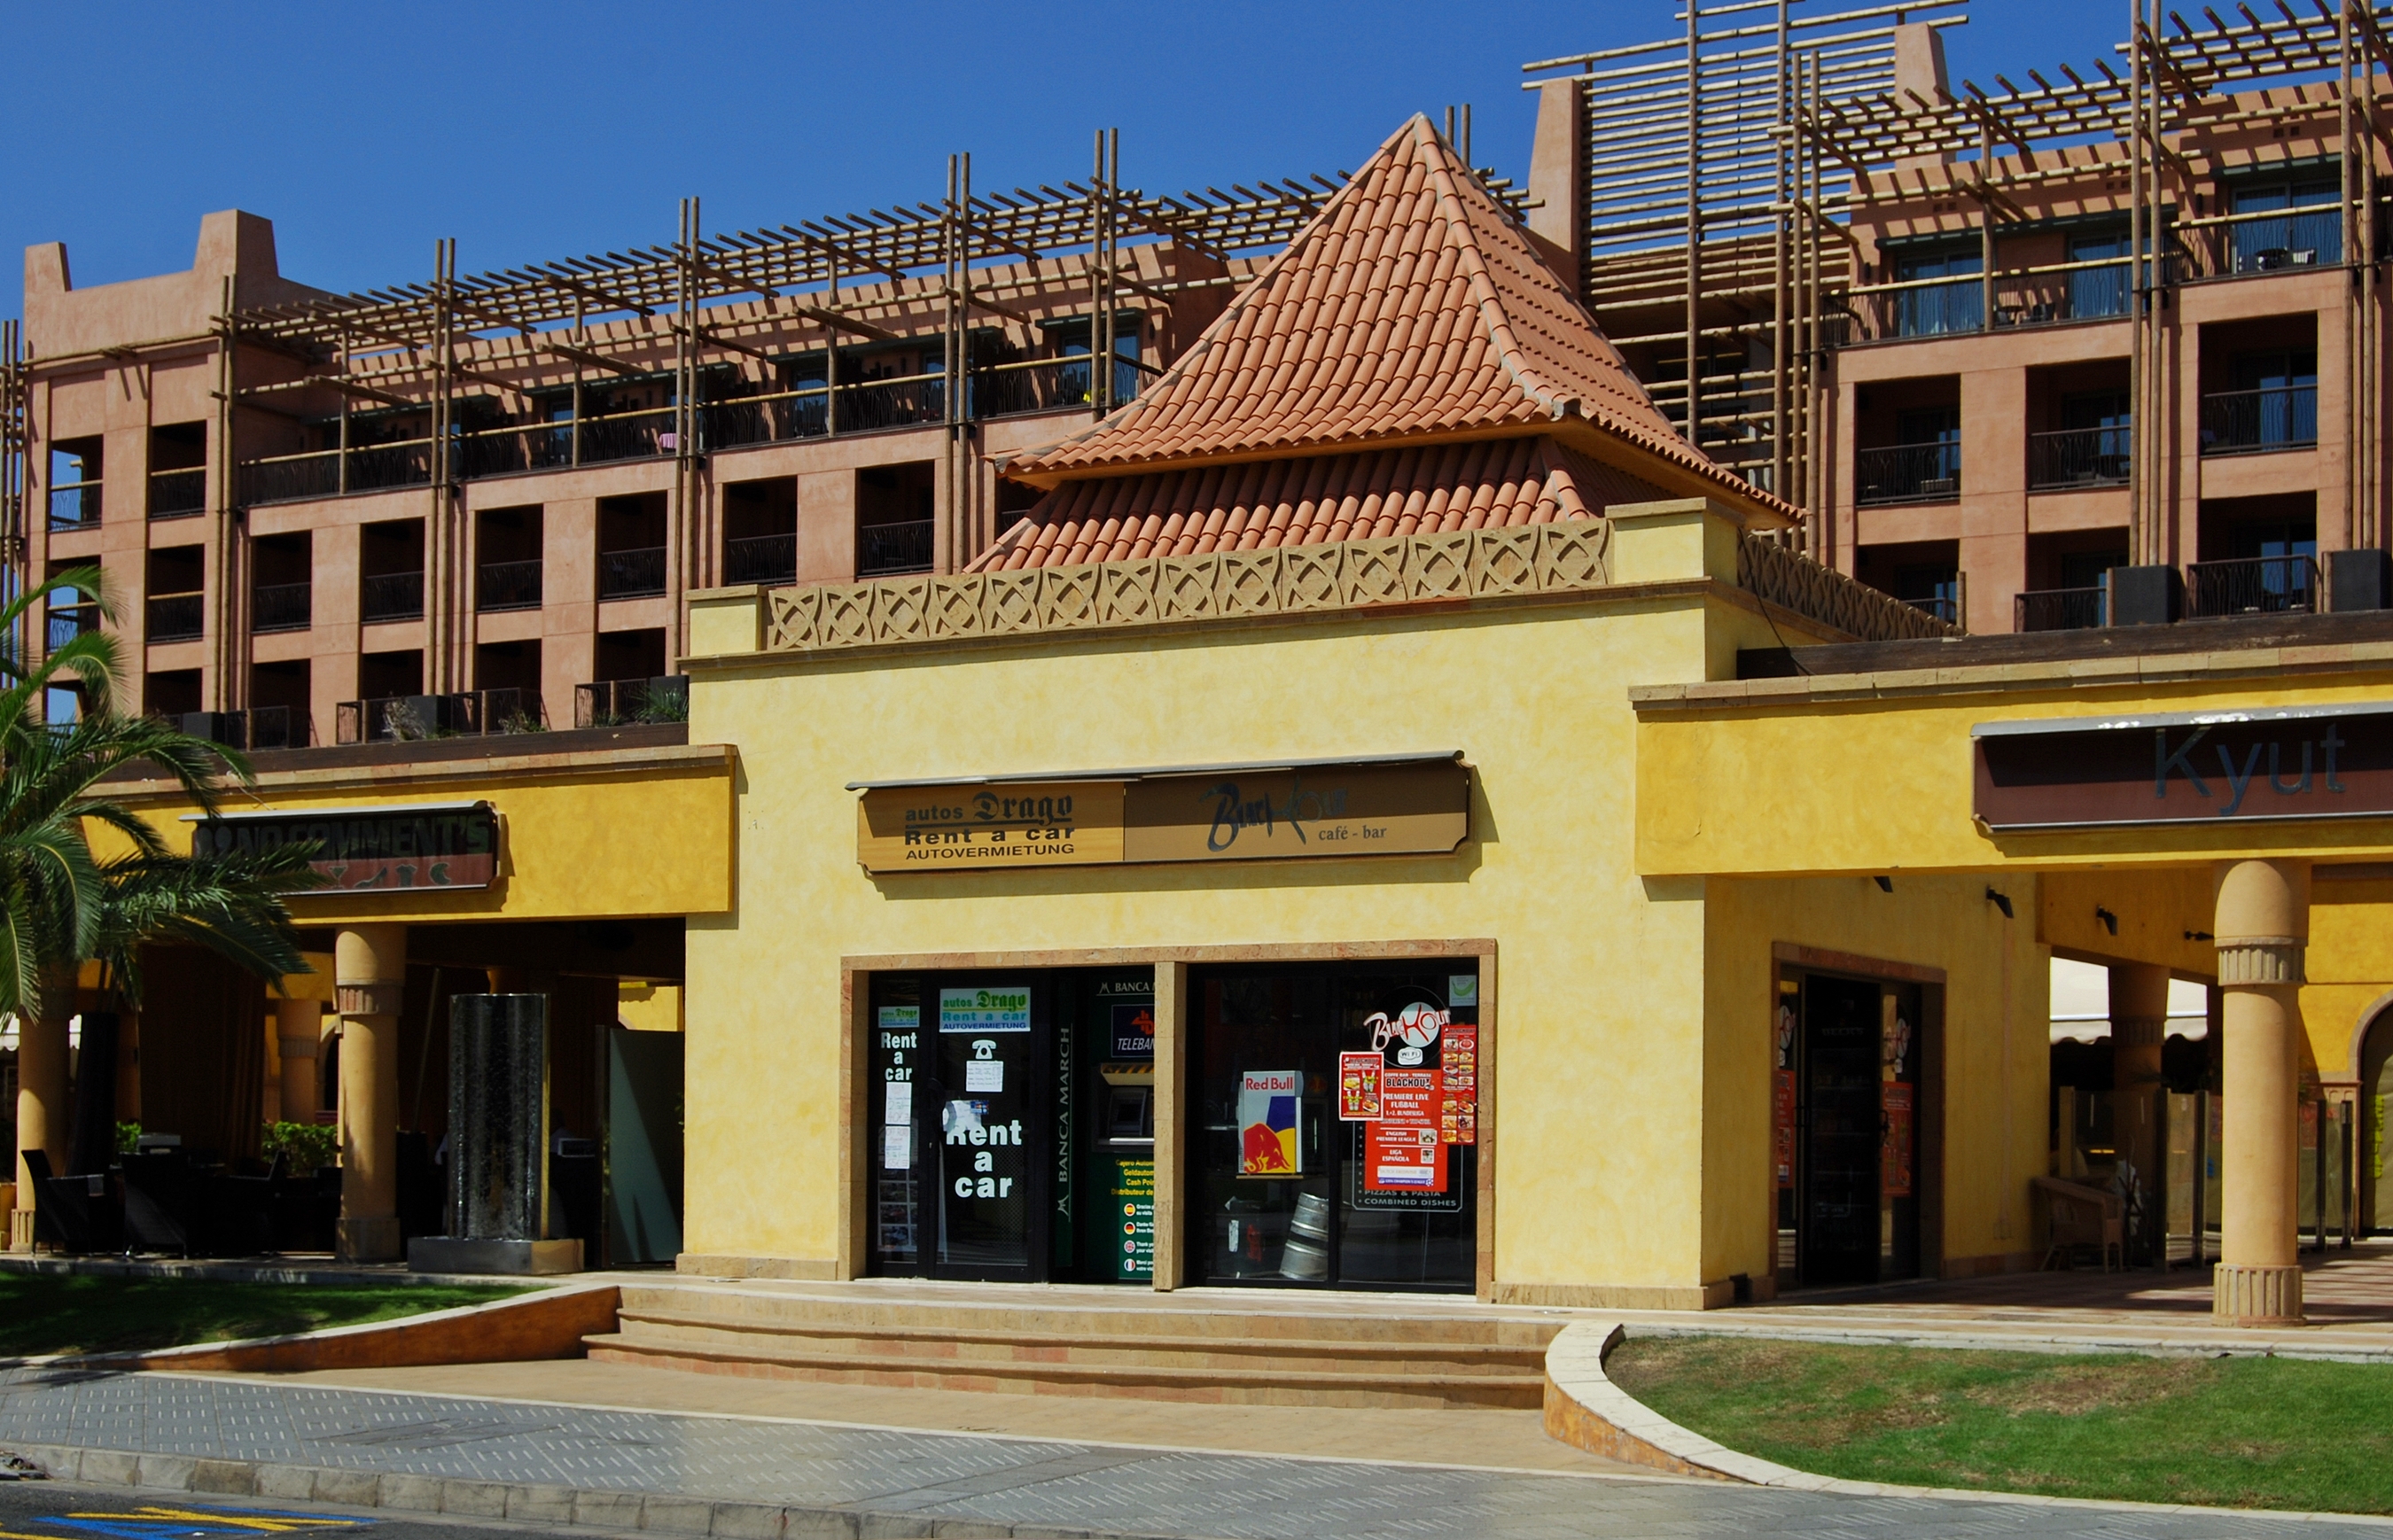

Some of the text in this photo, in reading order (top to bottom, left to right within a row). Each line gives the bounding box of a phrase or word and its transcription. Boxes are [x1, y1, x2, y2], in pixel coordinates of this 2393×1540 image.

[2155, 723, 2346, 817] Kyut
[905, 791, 1072, 826] autos Drago
[905, 827, 1075, 845] Rent a car
[1318, 826, 1348, 841] café
[1362, 825, 1387, 838] bar
[906, 844, 1074, 859] AUTOVERMIETUNG
[1114, 982, 1150, 992] BANCA
[942, 991, 1026, 1012] autos Drago
[942, 1012, 977, 1021] Rent
[881, 1032, 917, 1048] Rent
[1118, 1038, 1155, 1051] TELEBAN
[893, 1051, 903, 1064] a
[885, 1068, 912, 1081] car
[1245, 1077, 1293, 1090] Red Bull
[1059, 1028, 1070, 1182] BANCA MARCH
[974, 1151, 993, 1172] a
[955, 1177, 1012, 1198] car
